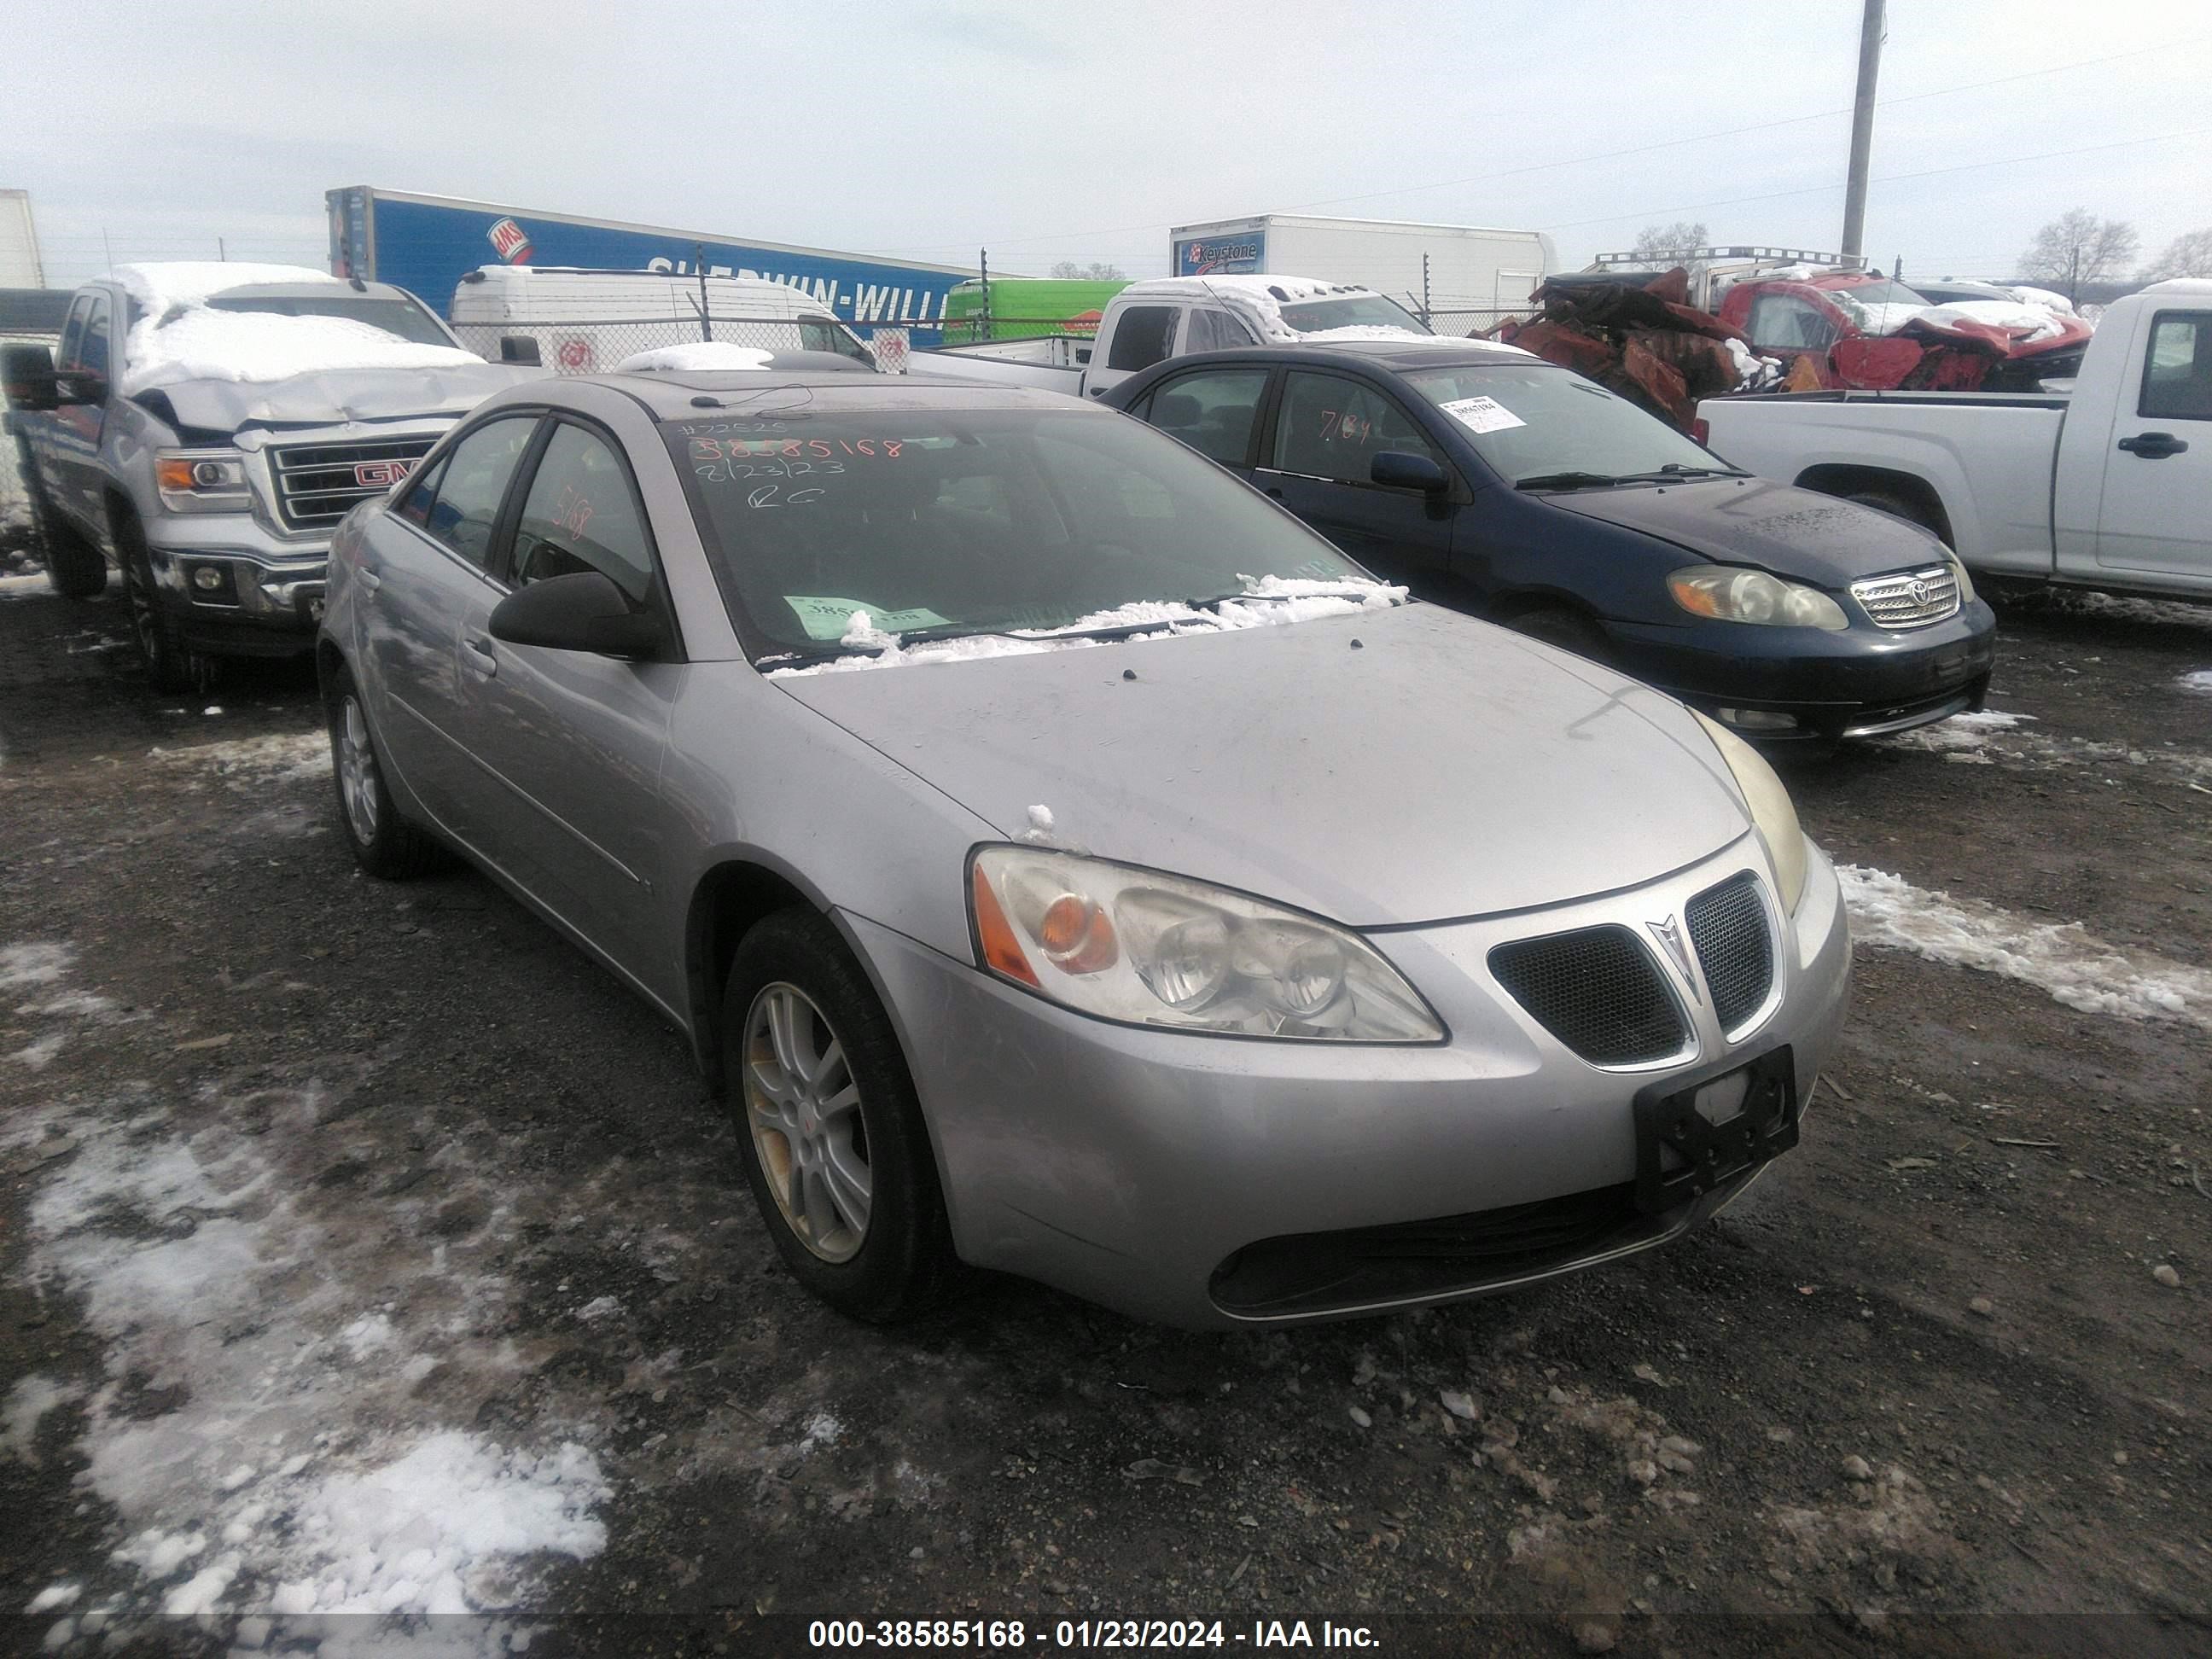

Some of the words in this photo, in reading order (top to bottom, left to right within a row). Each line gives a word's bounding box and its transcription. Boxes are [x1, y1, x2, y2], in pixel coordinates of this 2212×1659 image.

[494, 220, 522, 253] SWP
[1200, 243, 1257, 262] Keystone
[689, 437, 903, 459] 38585168
[354, 461, 424, 486] GM
